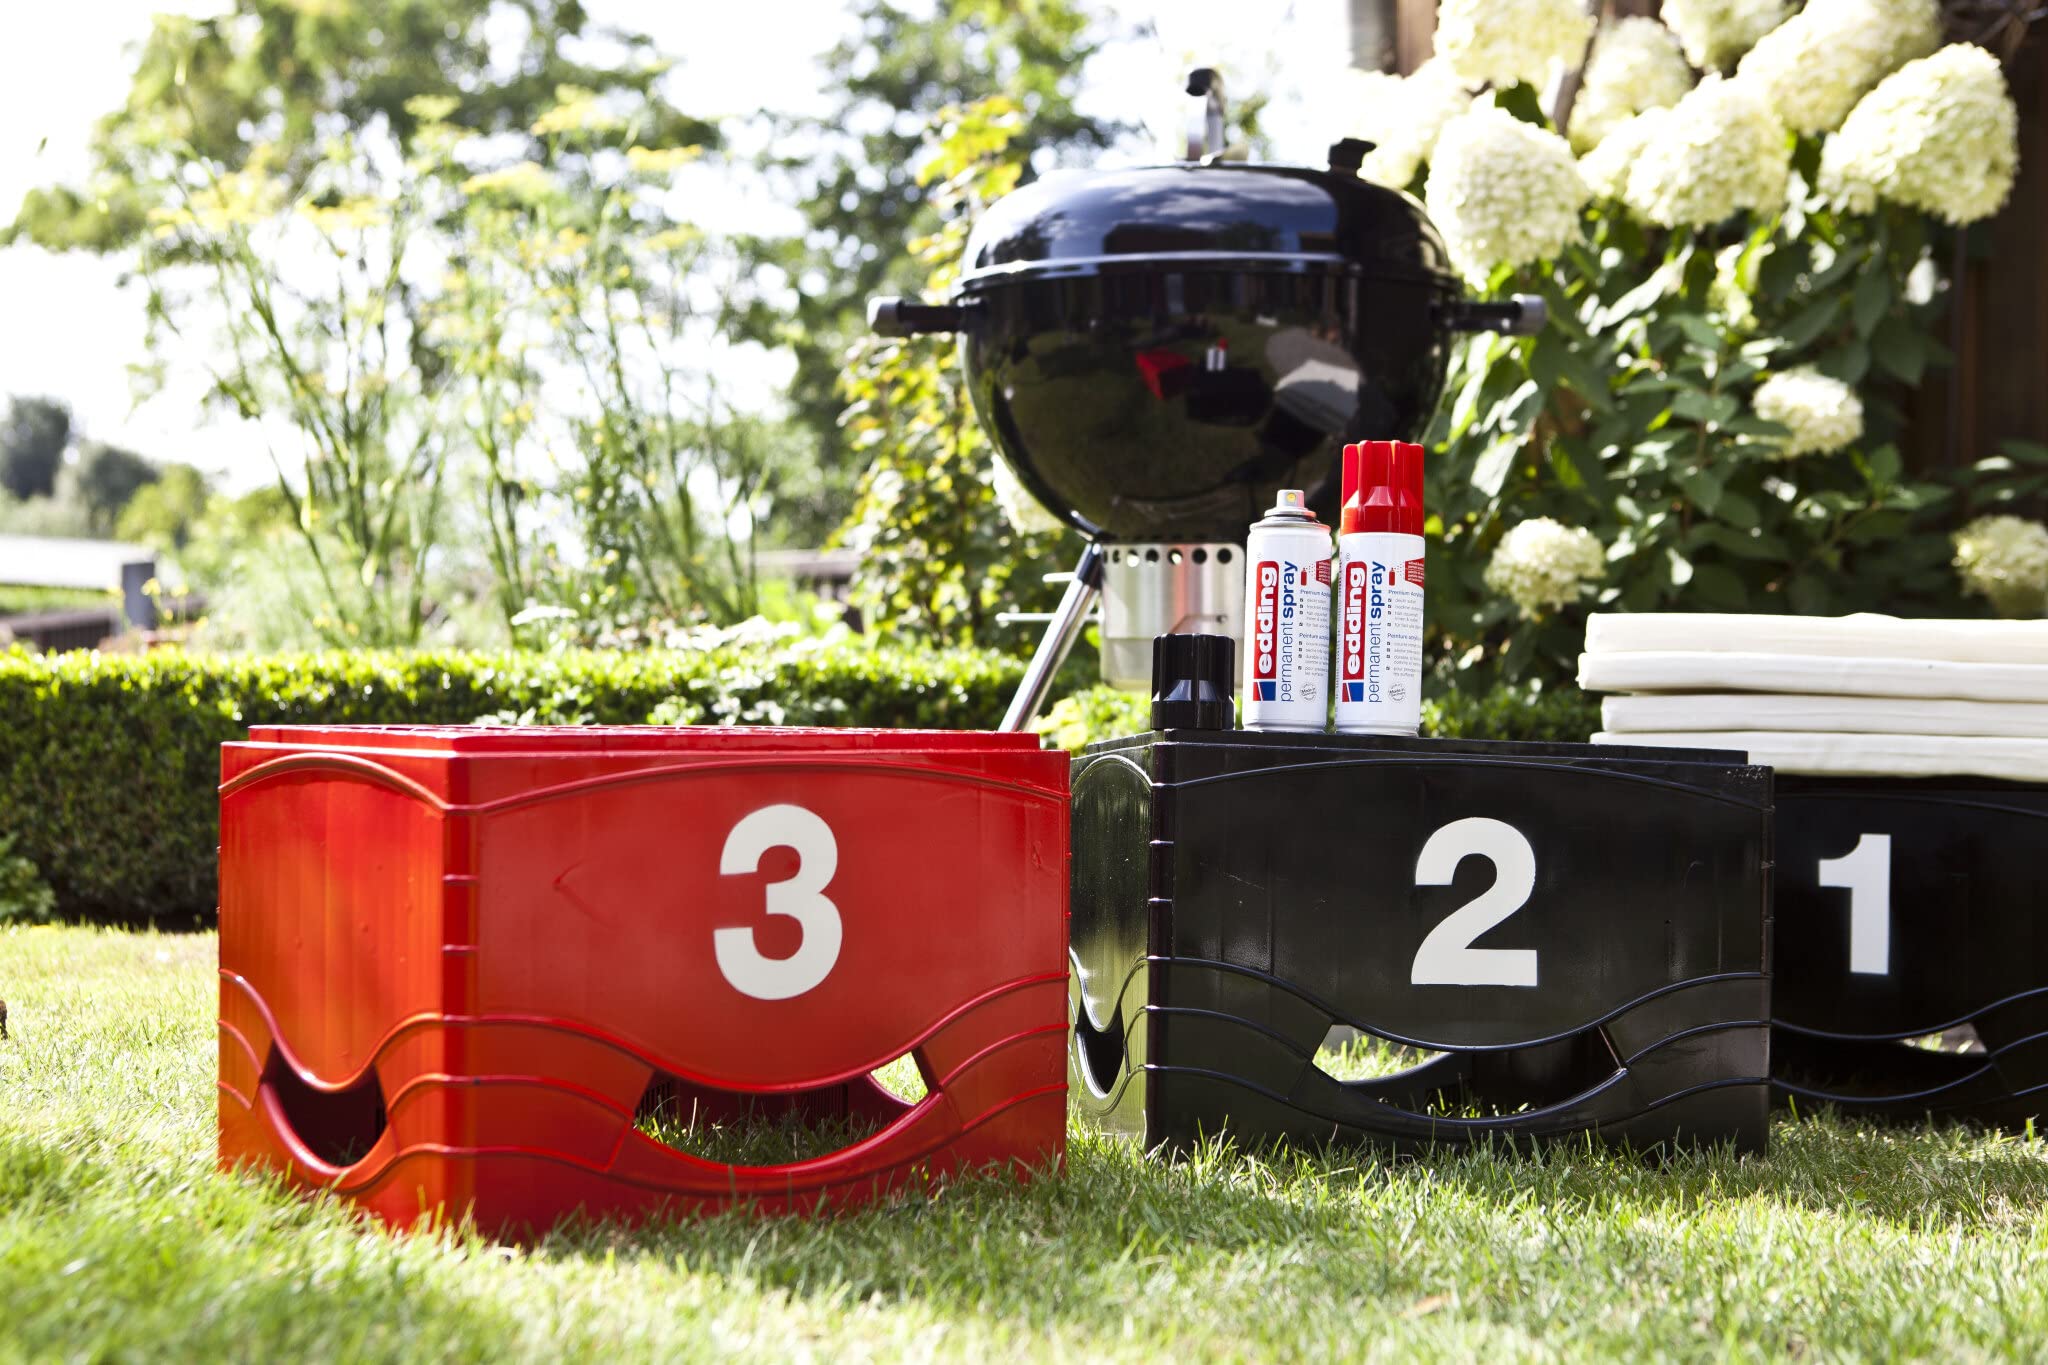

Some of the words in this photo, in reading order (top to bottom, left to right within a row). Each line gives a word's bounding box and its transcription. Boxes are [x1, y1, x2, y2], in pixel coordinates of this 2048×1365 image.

[1257, 567, 1277, 674] edding
[1282, 560, 1298, 619] spray
[1346, 567, 1365, 675] edding
[1370, 560, 1386, 619] spray
[1280, 621, 1294, 703] permanent
[1368, 621, 1382, 703] permanent
[714, 803, 843, 1000] 3
[1411, 817, 1538, 986] 2
[1819, 833, 1891, 975] 1
